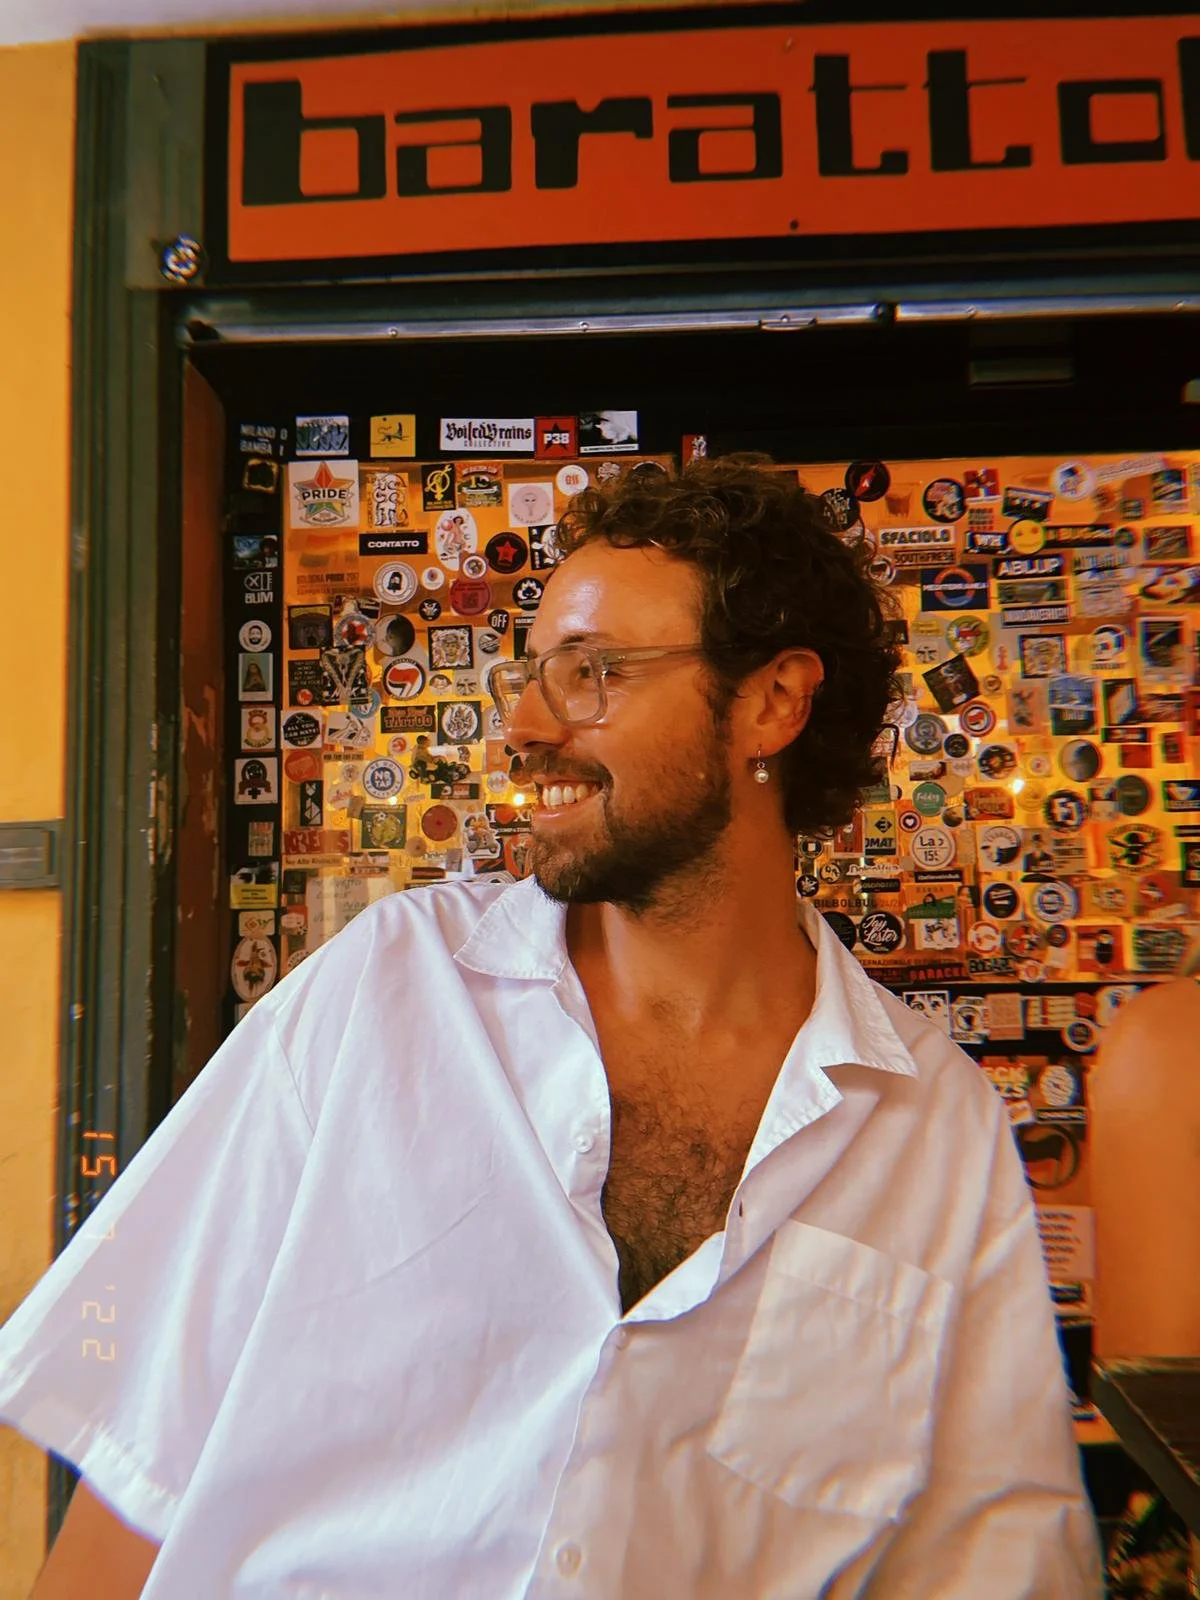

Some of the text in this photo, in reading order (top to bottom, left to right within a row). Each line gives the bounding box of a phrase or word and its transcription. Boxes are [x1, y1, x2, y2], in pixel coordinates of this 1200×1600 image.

[544, 432, 569, 445] P38
[302, 489, 347, 500] PRIDE
[367, 540, 420, 548] CONTATTO
[245, 592, 273, 604] BUM
[491, 614, 507, 628] OFF
[383, 715, 433, 728] TATTOO
[862, 913, 888, 932] Jay
[863, 924, 898, 946] Lester
